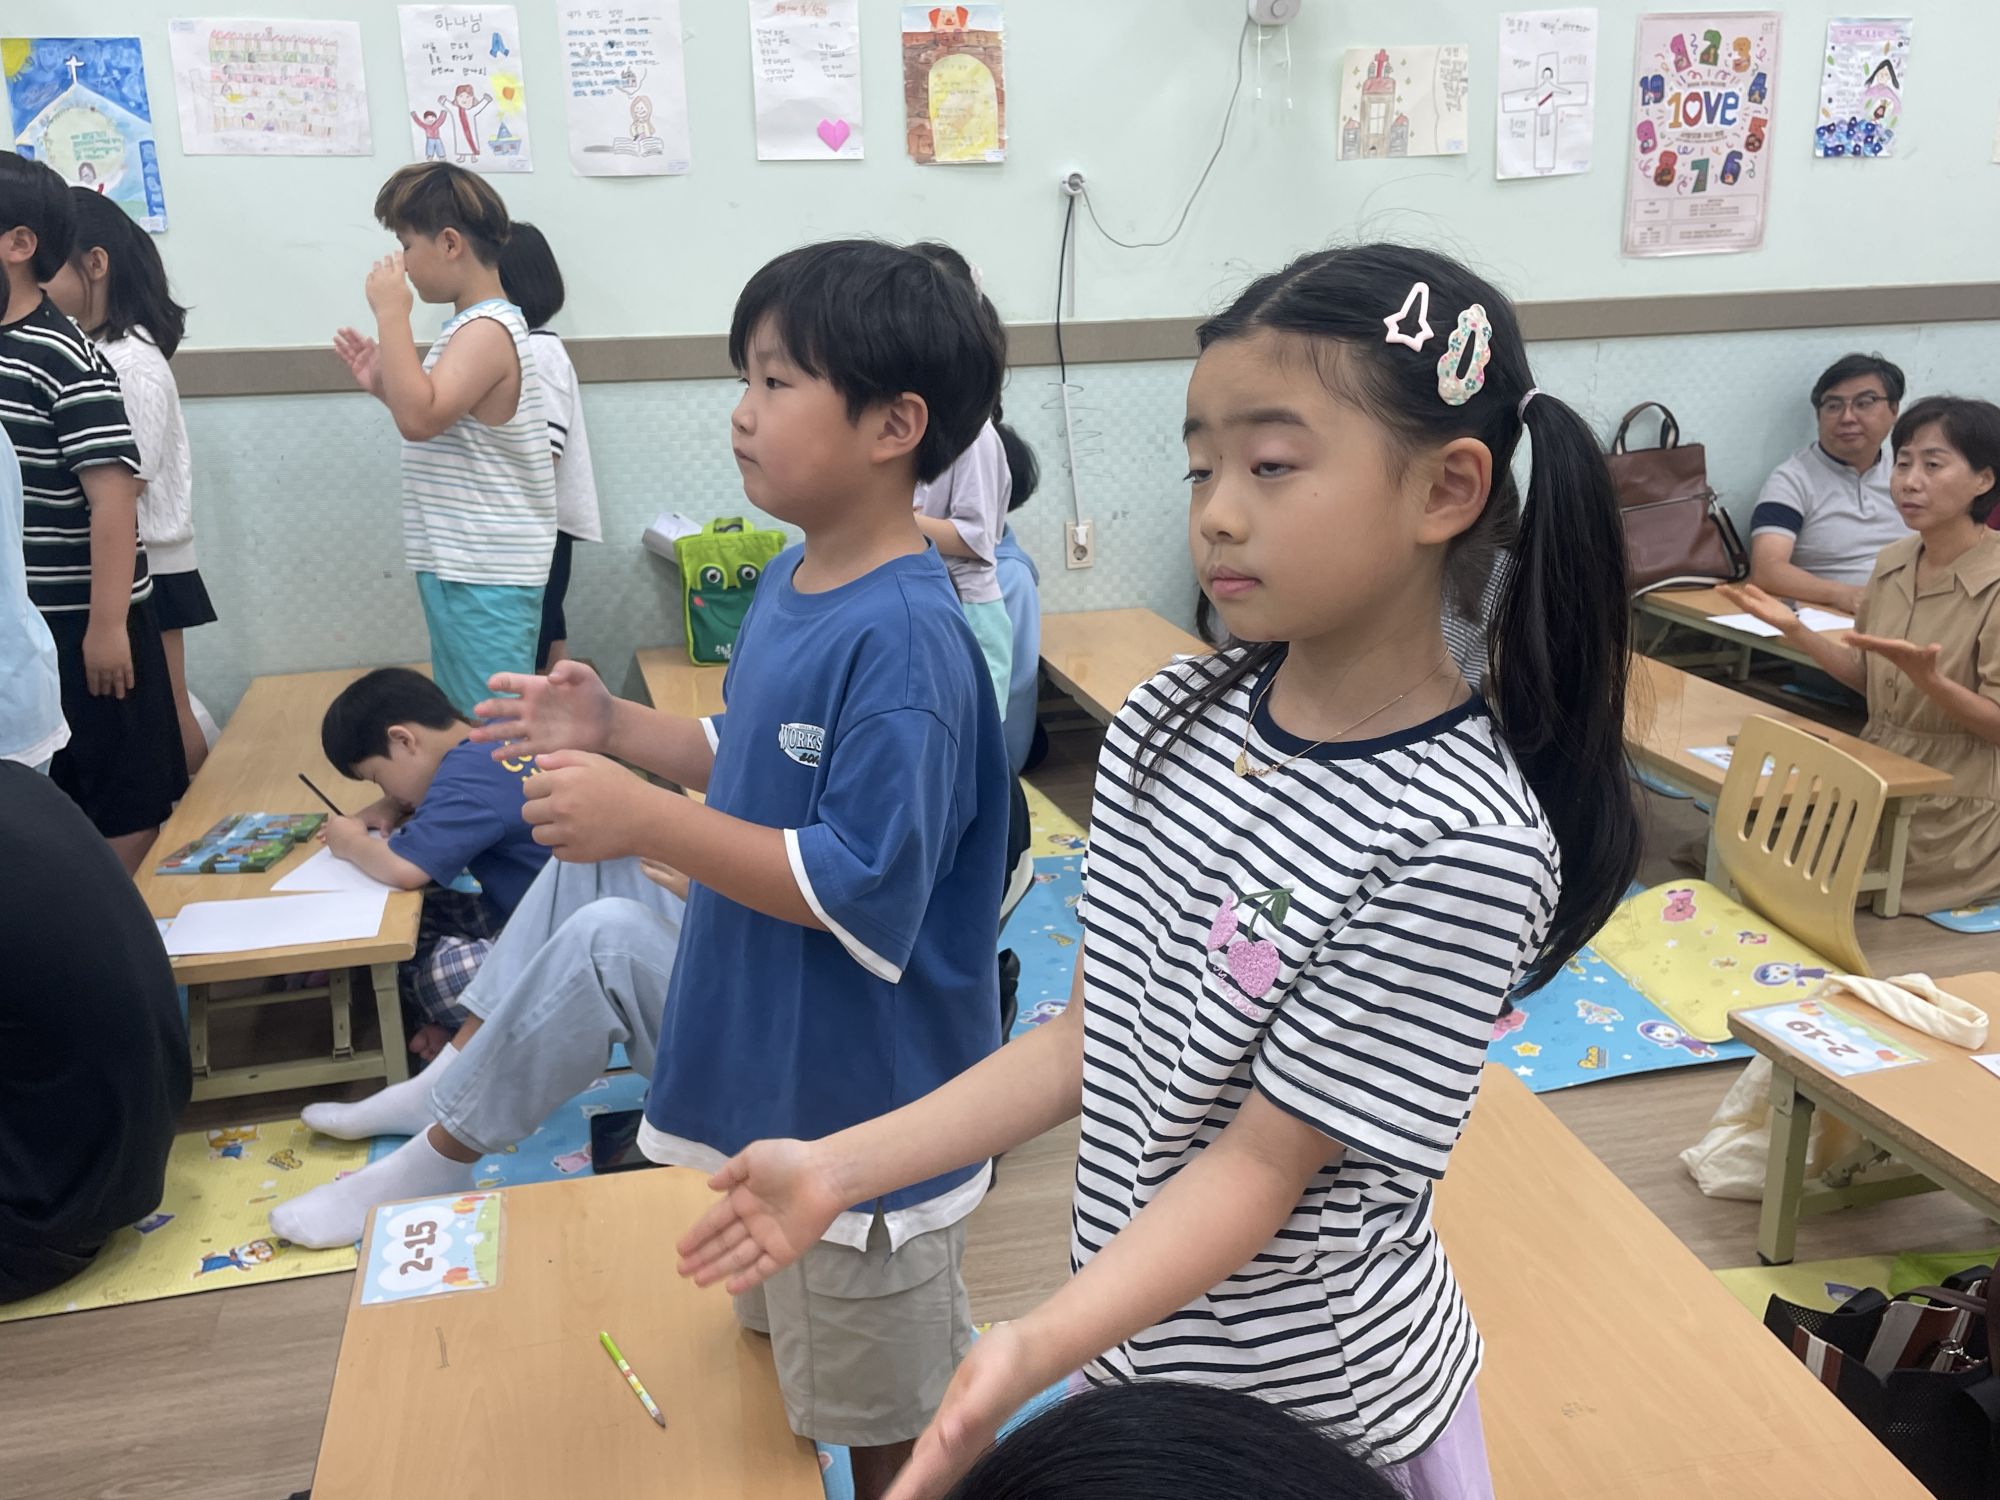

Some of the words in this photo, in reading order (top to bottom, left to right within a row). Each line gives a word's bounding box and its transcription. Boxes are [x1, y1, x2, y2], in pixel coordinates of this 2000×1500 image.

[434, 12, 483, 33] 하나님
[780, 723, 823, 752] WORKS
[1786, 1020, 1859, 1056] 2-19
[399, 1220, 438, 1275] 2-15
